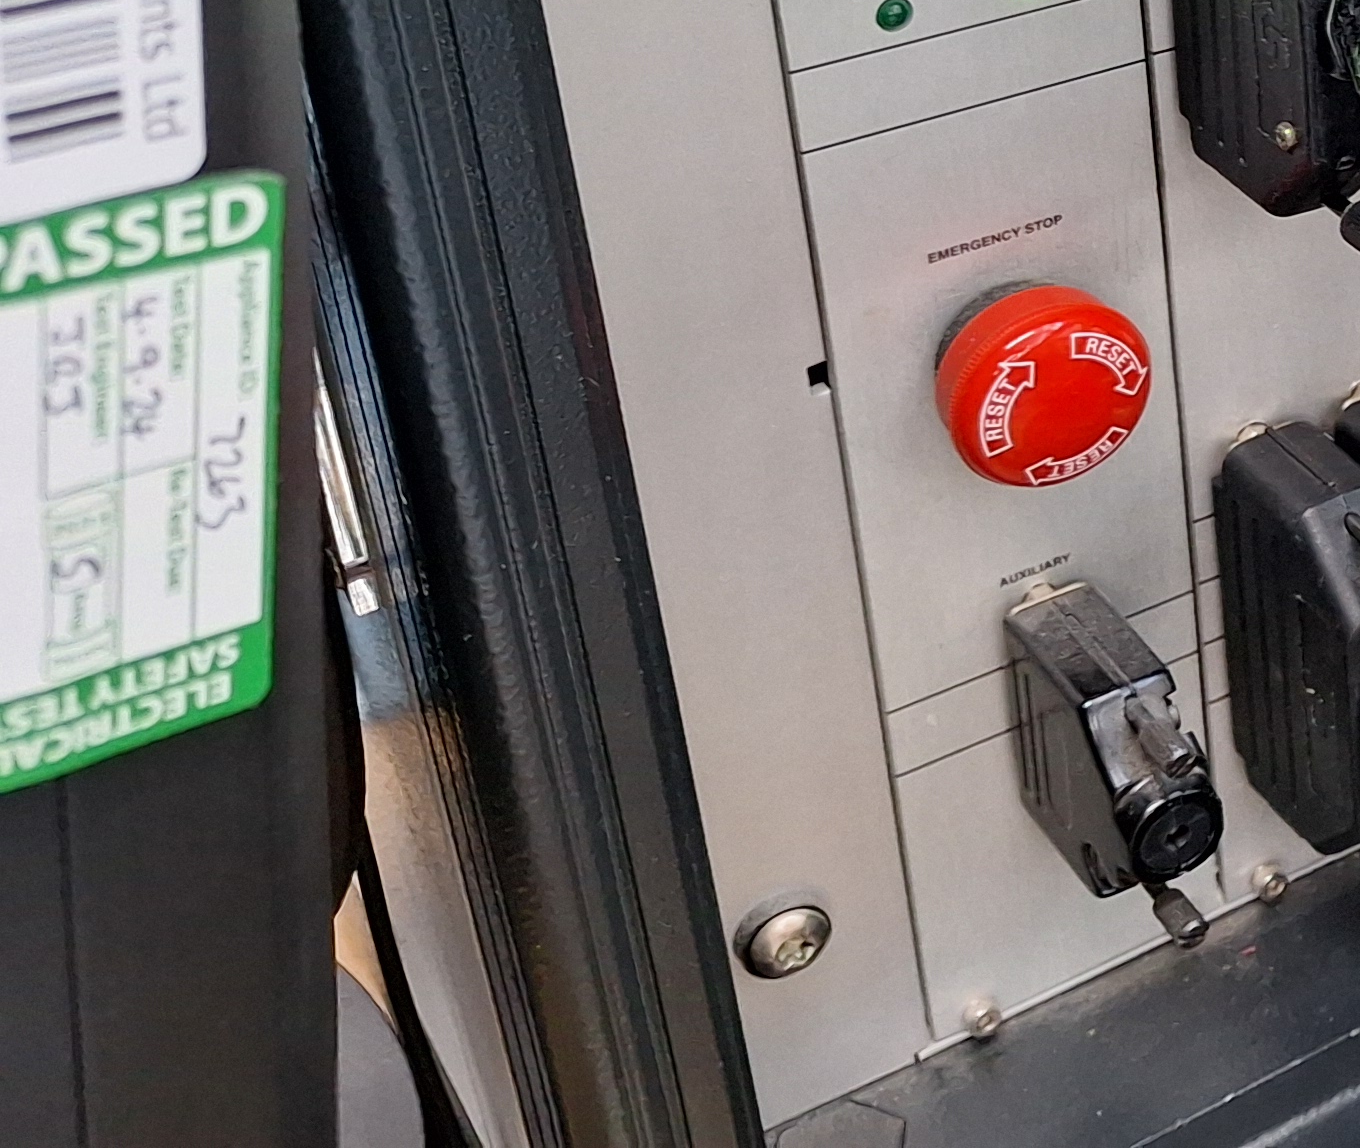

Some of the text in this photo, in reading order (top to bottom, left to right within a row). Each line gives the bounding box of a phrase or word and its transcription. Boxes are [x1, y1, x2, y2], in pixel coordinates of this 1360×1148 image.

[141, 71, 189, 145] Ltd
[0, 184, 268, 293] ASSED
[926, 213, 1064, 266] EMERGENCY STOP
[1084, 336, 1138, 378] RESET
[985, 379, 1019, 442] RESET
[196, 415, 247, 530] 7263
[1047, 437, 1114, 478] RESET
[998, 552, 1071, 588] AUXILIARY
[0, 632, 241, 742] SAFETY TES
